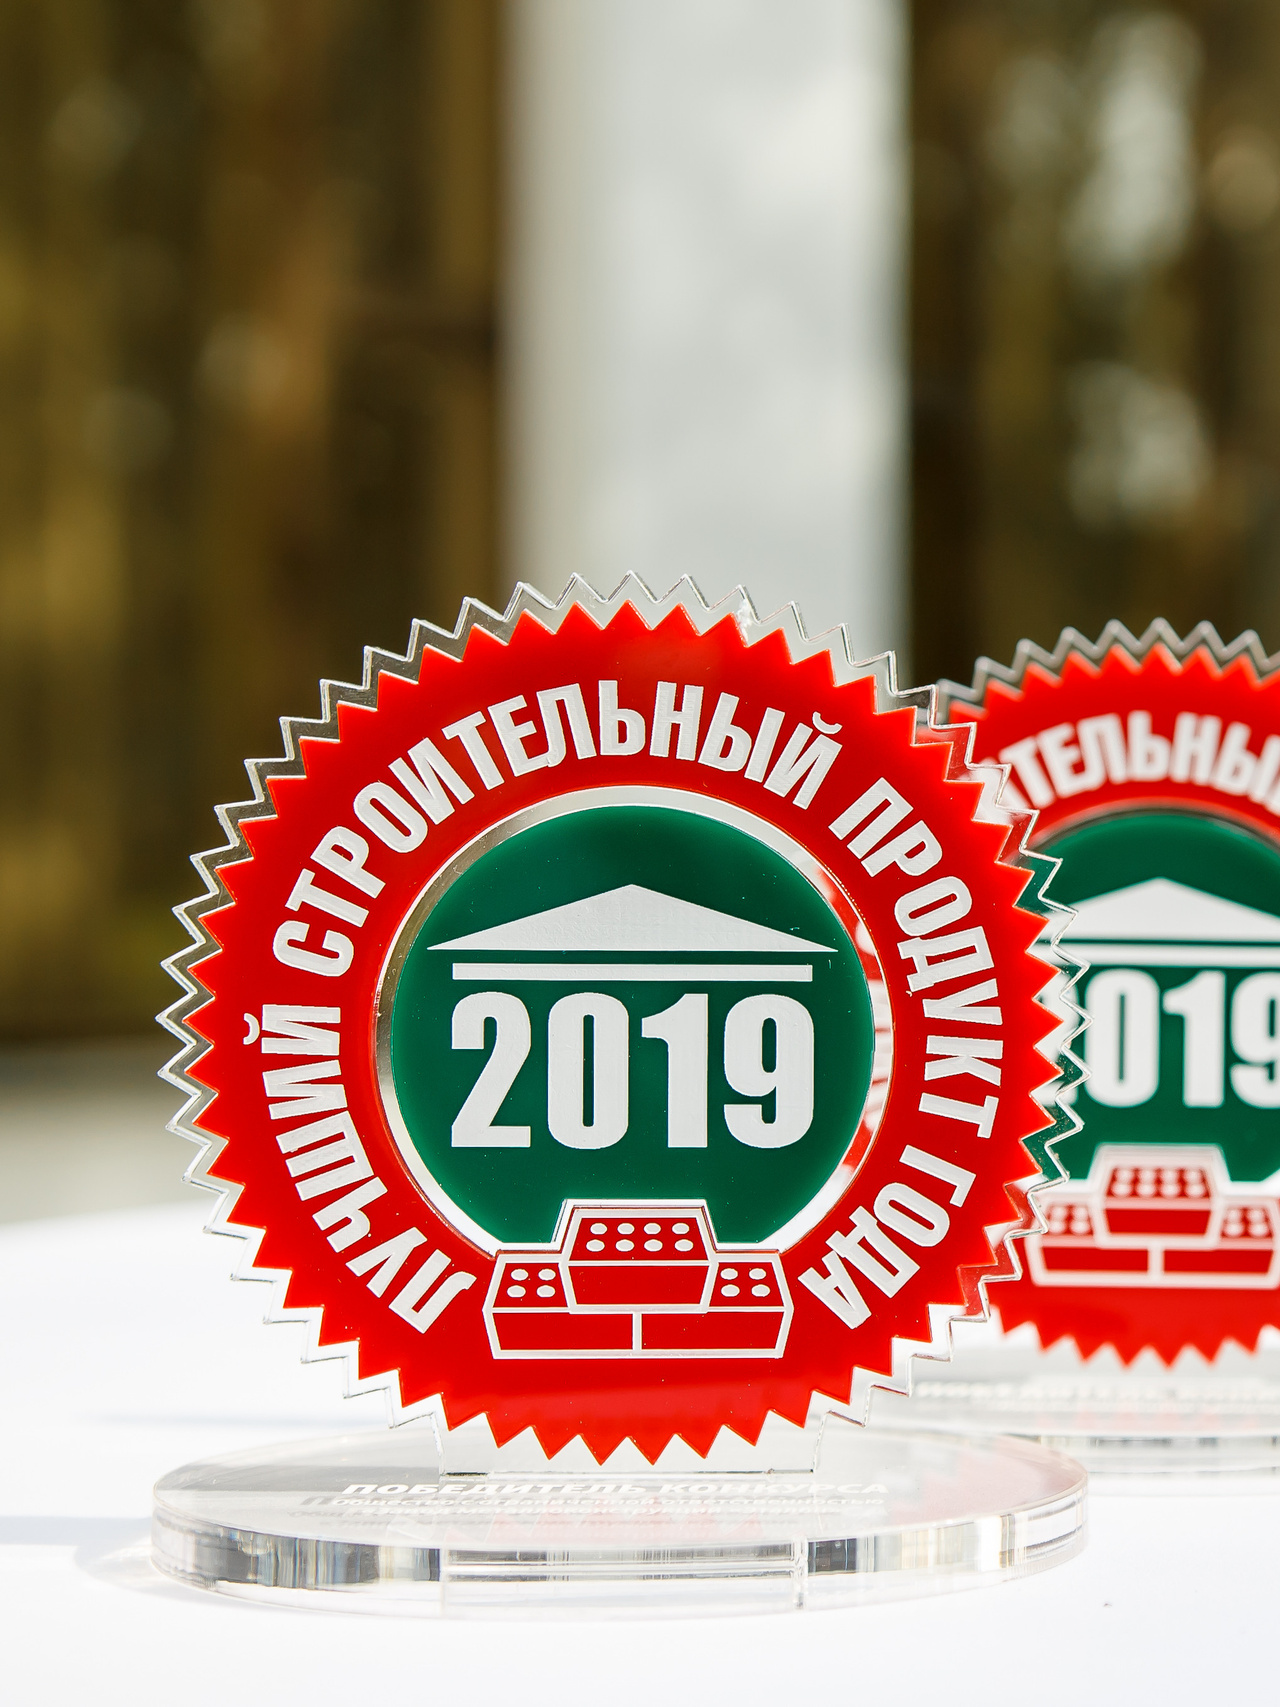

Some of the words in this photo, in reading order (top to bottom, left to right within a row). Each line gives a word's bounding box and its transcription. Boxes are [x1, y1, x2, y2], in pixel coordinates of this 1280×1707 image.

[272, 679, 843, 977] СТРОИТЕЛЬНЫЙ
[828, 777, 1004, 1139] ПРОДУКТ
[450, 991, 815, 1149] 2019
[243, 1004, 477, 1334] ЛУЧШИЙ
[797, 1144, 977, 1330] ГОДА
[329, 1498, 456, 1507] Общество
[479, 1498, 655, 1507] ограниченной
[341, 1483, 647, 1495] ПОБЕДИТЕЛЬ
[658, 1483, 889, 1494] КОНКУРСА
